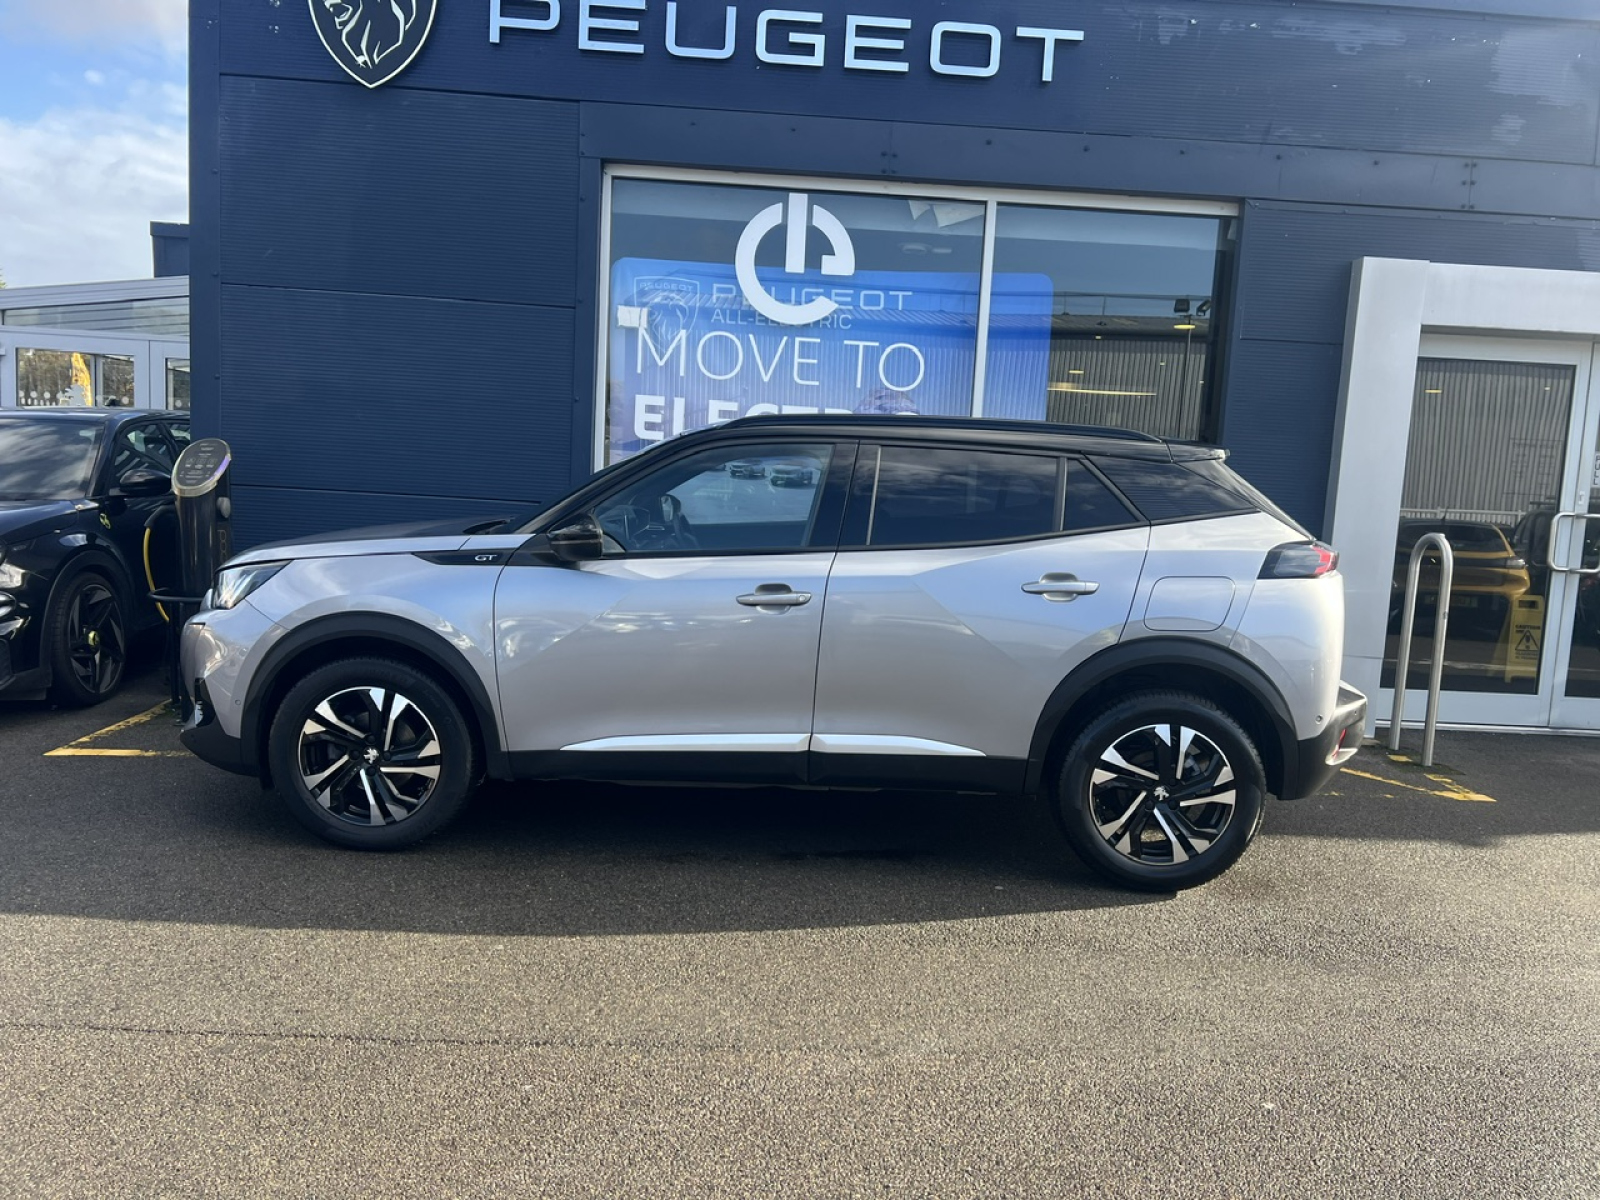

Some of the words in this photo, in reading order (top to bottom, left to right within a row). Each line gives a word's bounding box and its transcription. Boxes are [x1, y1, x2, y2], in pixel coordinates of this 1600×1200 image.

[489, 0, 1085, 82] PEUGEOT
[636, 326, 820, 386] MOVE
[844, 340, 925, 392] TO
